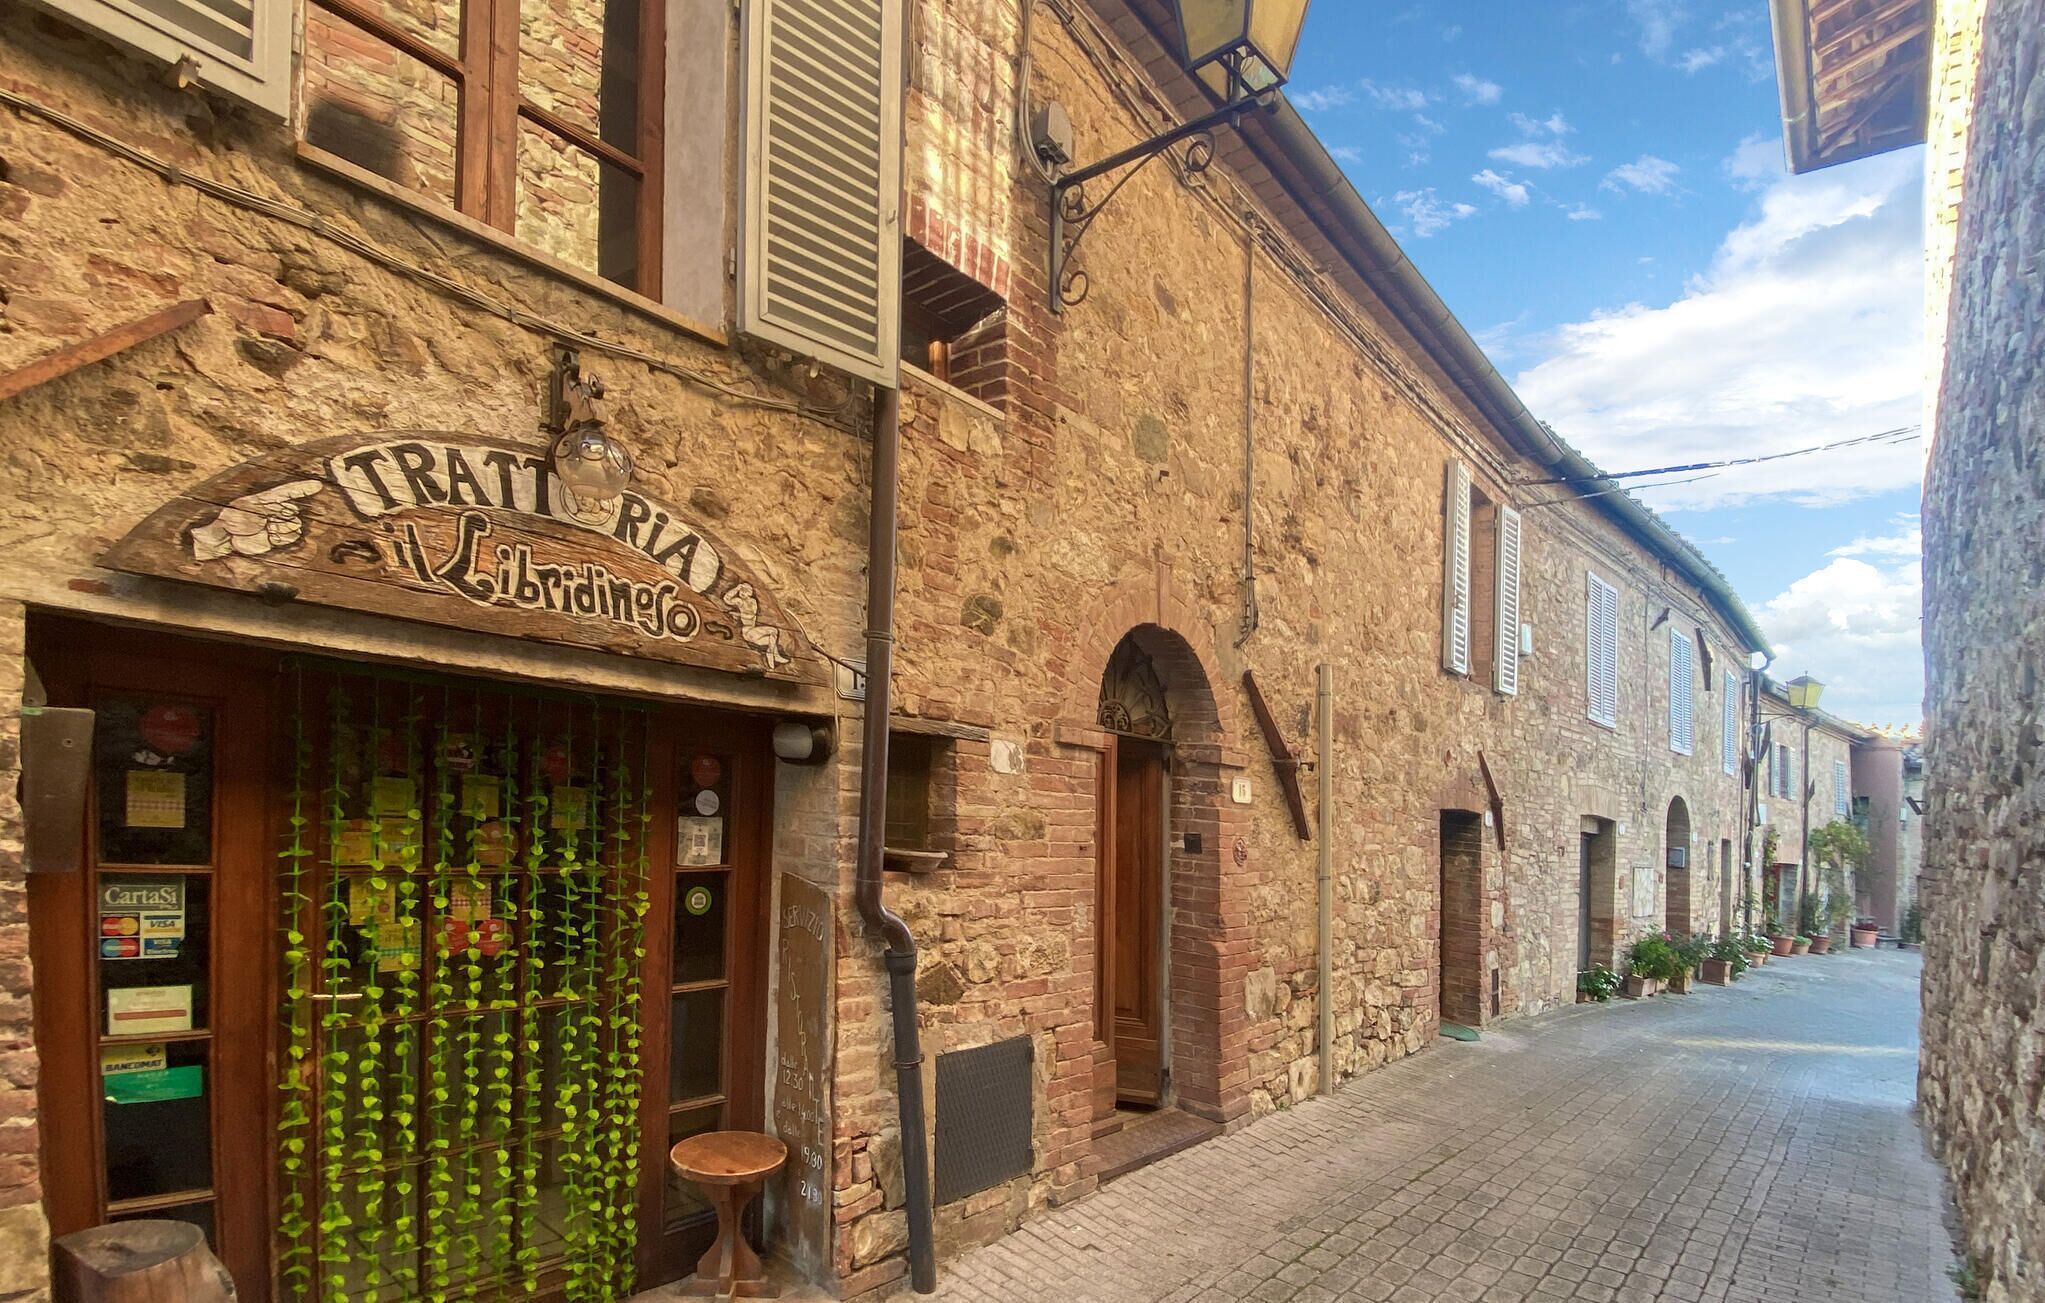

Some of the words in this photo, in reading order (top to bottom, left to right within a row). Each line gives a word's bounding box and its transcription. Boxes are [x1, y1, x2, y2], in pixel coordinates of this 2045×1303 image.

[149, 920, 176, 928] VISA
[783, 904, 824, 942] SERVIZIO
[783, 1068, 804, 1091] 12.30
